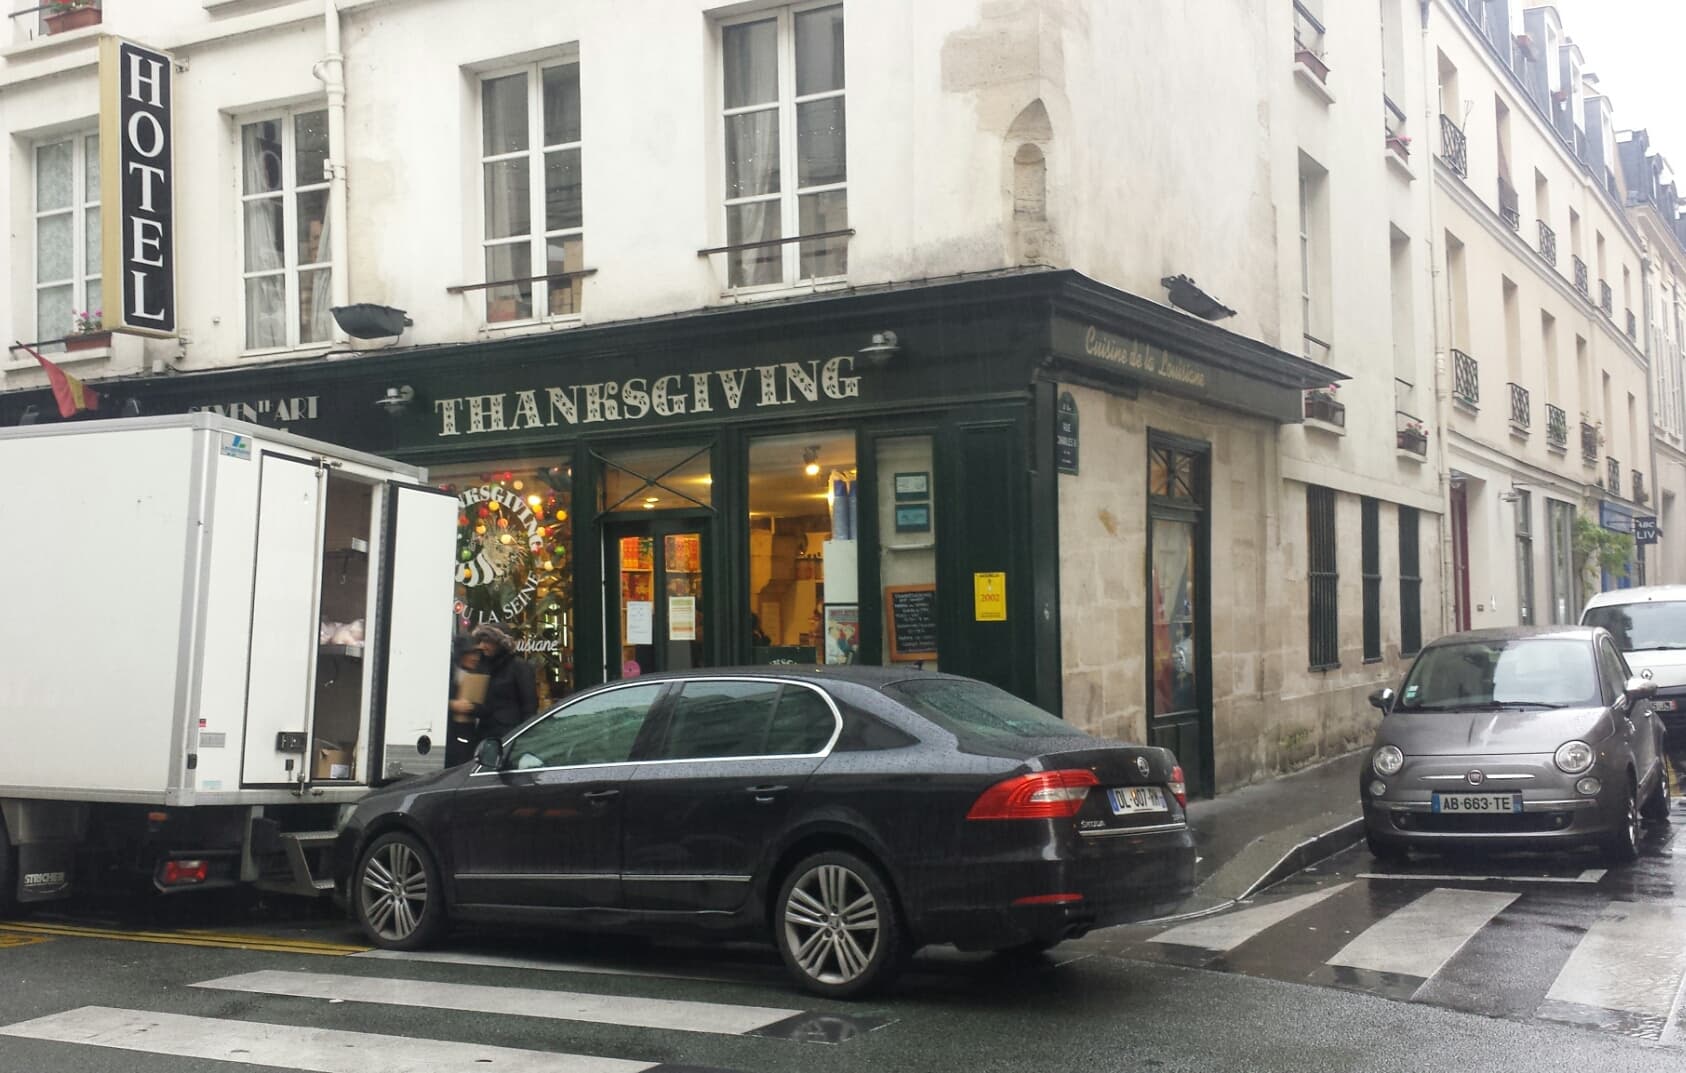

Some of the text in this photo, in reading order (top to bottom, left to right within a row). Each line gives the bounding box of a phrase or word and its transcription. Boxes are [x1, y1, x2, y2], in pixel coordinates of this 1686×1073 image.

[127, 52, 165, 321] HOTEL
[1085, 325, 1128, 364] Cuisine
[1129, 339, 1142, 368] de
[1144, 344, 1155, 371] la
[274, 396, 319, 421] ART
[434, 356, 861, 436] THANKSGIVING
[478, 610, 500, 625] LA
[502, 570, 540, 620] SEINE
[1443, 796, 1511, 810] AB-663-TE
